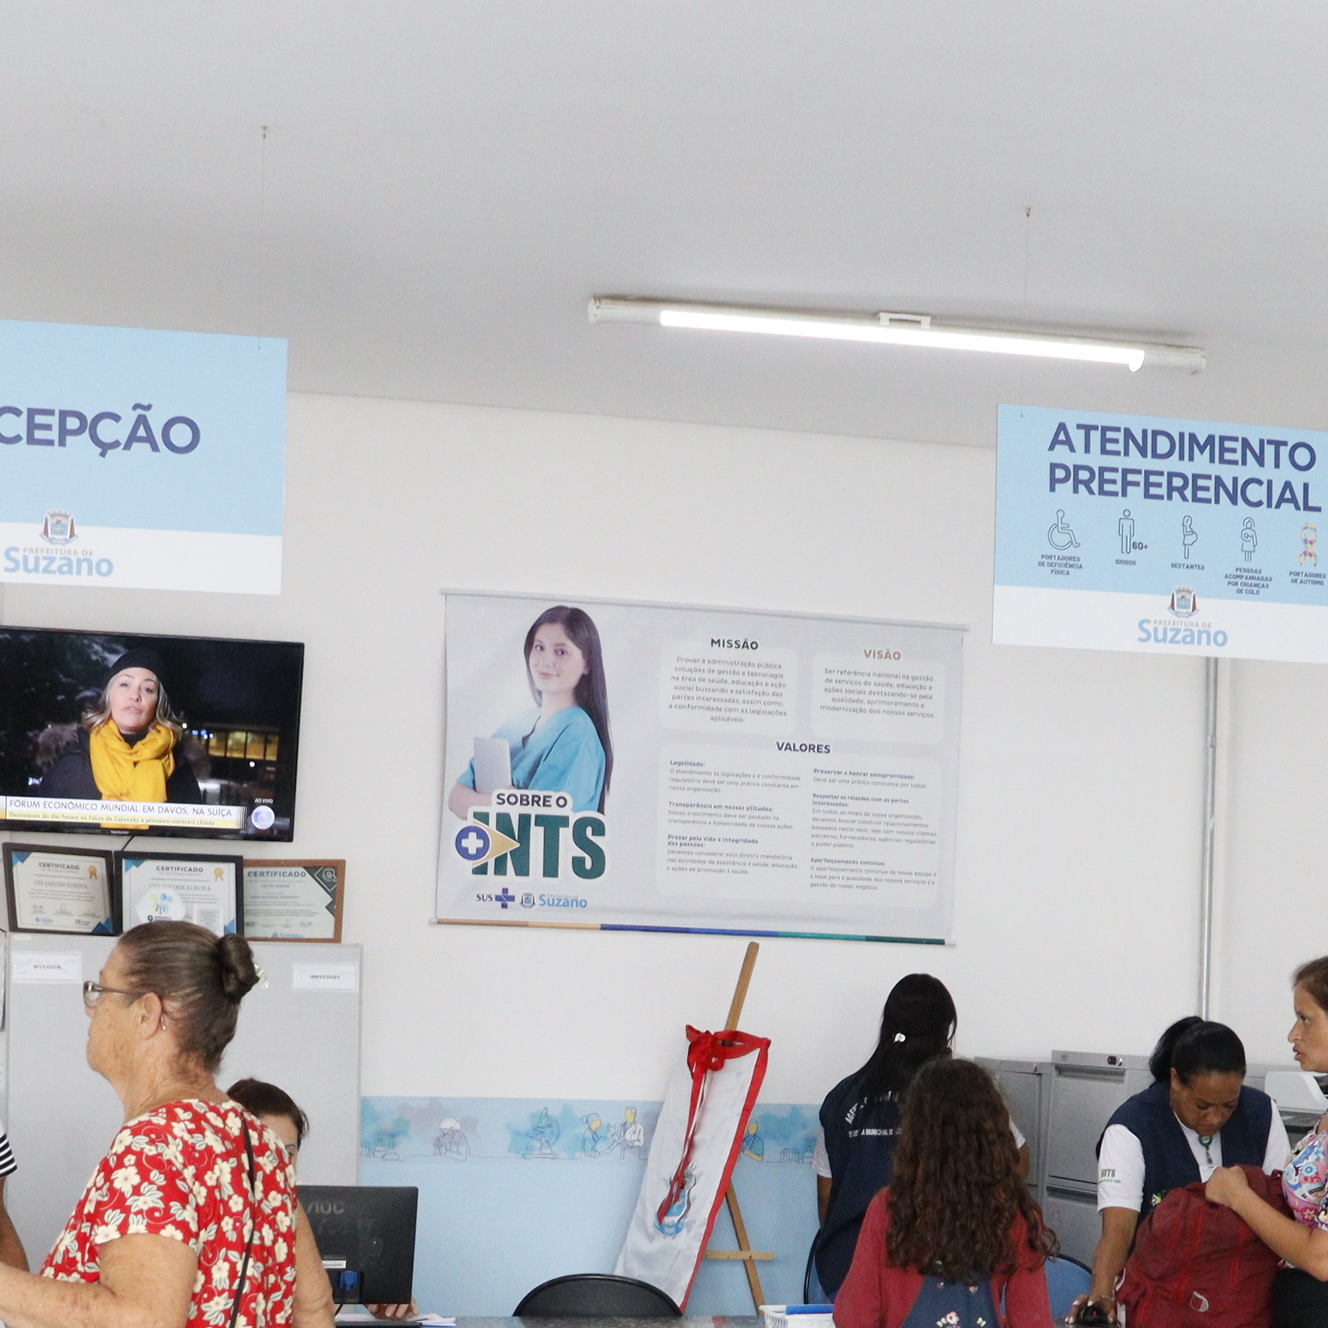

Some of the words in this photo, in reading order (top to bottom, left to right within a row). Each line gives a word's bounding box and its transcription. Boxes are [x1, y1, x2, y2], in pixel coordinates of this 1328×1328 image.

[1047, 422, 1317, 472] ATENDIMENTO
[1048, 462, 1322, 513] PREFERENCIAL
[22, 546, 79, 556] PREFEITURA
[1132, 542, 1148, 550] 60+
[4, 546, 114, 577] Suzano
[1047, 561, 1083, 570] DEFICIÊNCIA
[1289, 571, 1326, 579] PORTADORES
[1153, 619, 1199, 627] PREFEITURA
[1138, 619, 1228, 647] Suzano
[711, 638, 759, 650] MISSÃO
[864, 648, 901, 660] VISÃO
[707, 658, 755, 668] administração
[674, 666, 705, 674] soluções
[748, 671, 783, 679] tecnologia
[708, 678, 730, 686] saúde,
[732, 679, 763, 687] educação
[874, 681, 895, 689] saúde,
[897, 682, 927, 691] educação
[735, 689, 769, 697] satisfação
[750, 708, 786, 717] legislações
[776, 741, 831, 754] VALORES
[496, 793, 552, 807] SOBRE
[556, 796, 568, 808] O
[44, 801, 97, 811] ECONÔMICO
[101, 803, 139, 812] MUNDIAL
[143, 805, 154, 813] EM
[158, 805, 190, 815] DAVOS,
[208, 807, 232, 817] SUÍÇA
[39, 862, 80, 870] CERTIFICADO
[476, 893, 493, 902] SUS
[538, 894, 588, 908] Suzano
